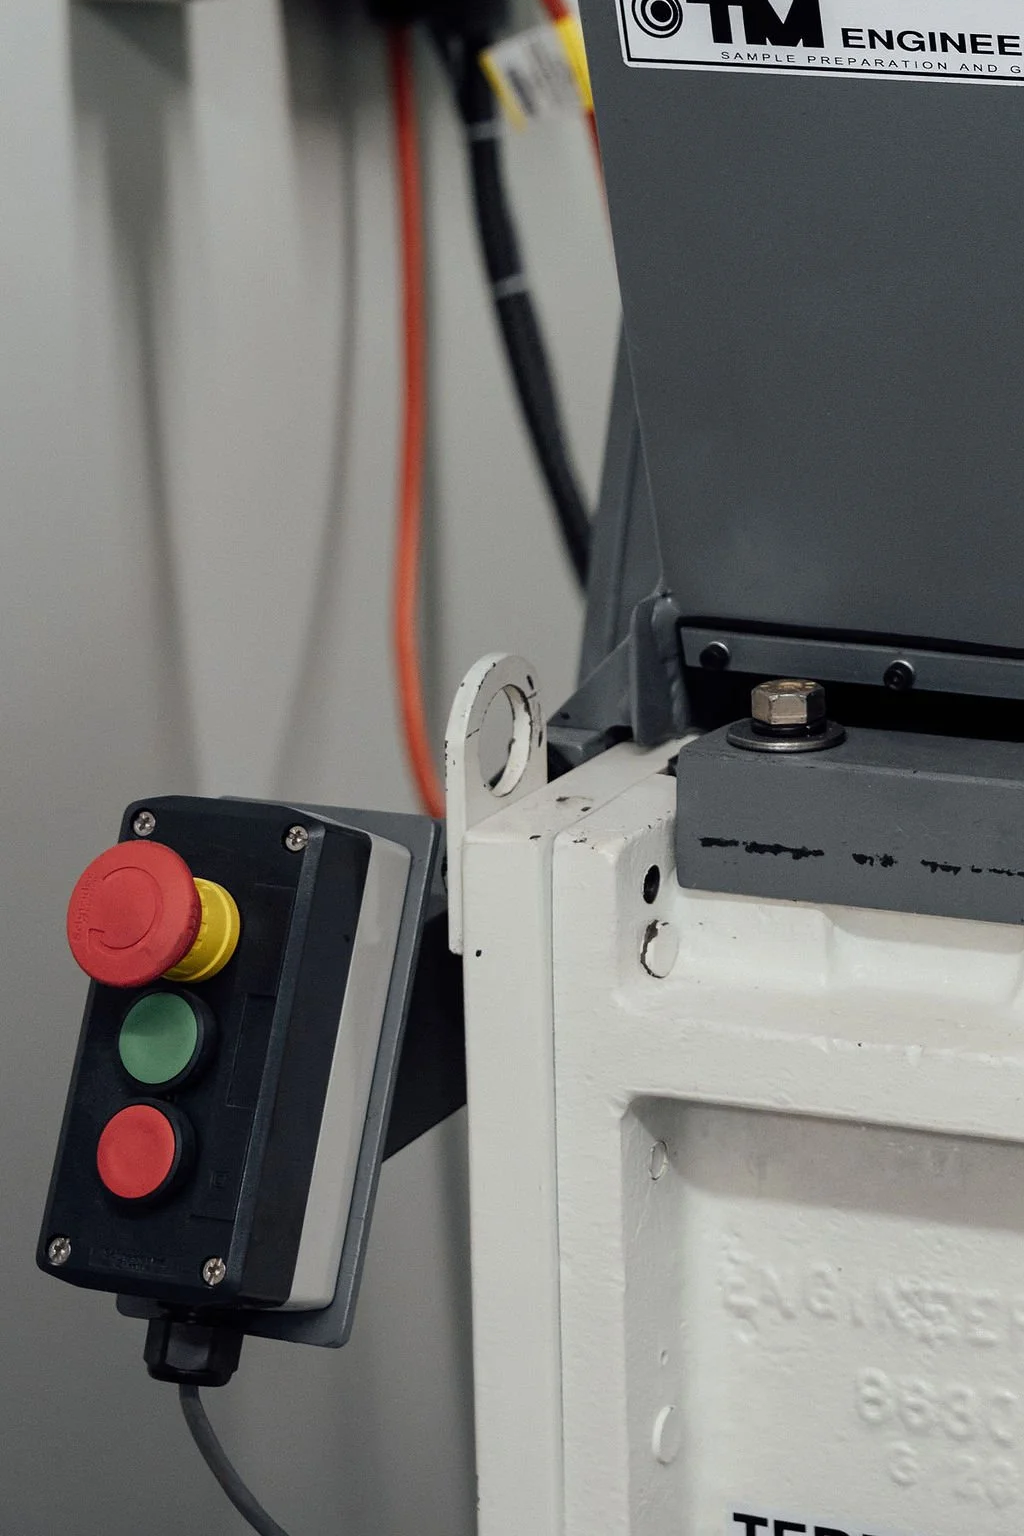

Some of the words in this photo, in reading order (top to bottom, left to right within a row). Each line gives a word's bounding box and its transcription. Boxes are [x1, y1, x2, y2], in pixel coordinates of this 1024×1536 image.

[721, 51, 796, 63] SAMPLE
[807, 55, 948, 71] PREPARATION
[959, 63, 998, 74] AND
